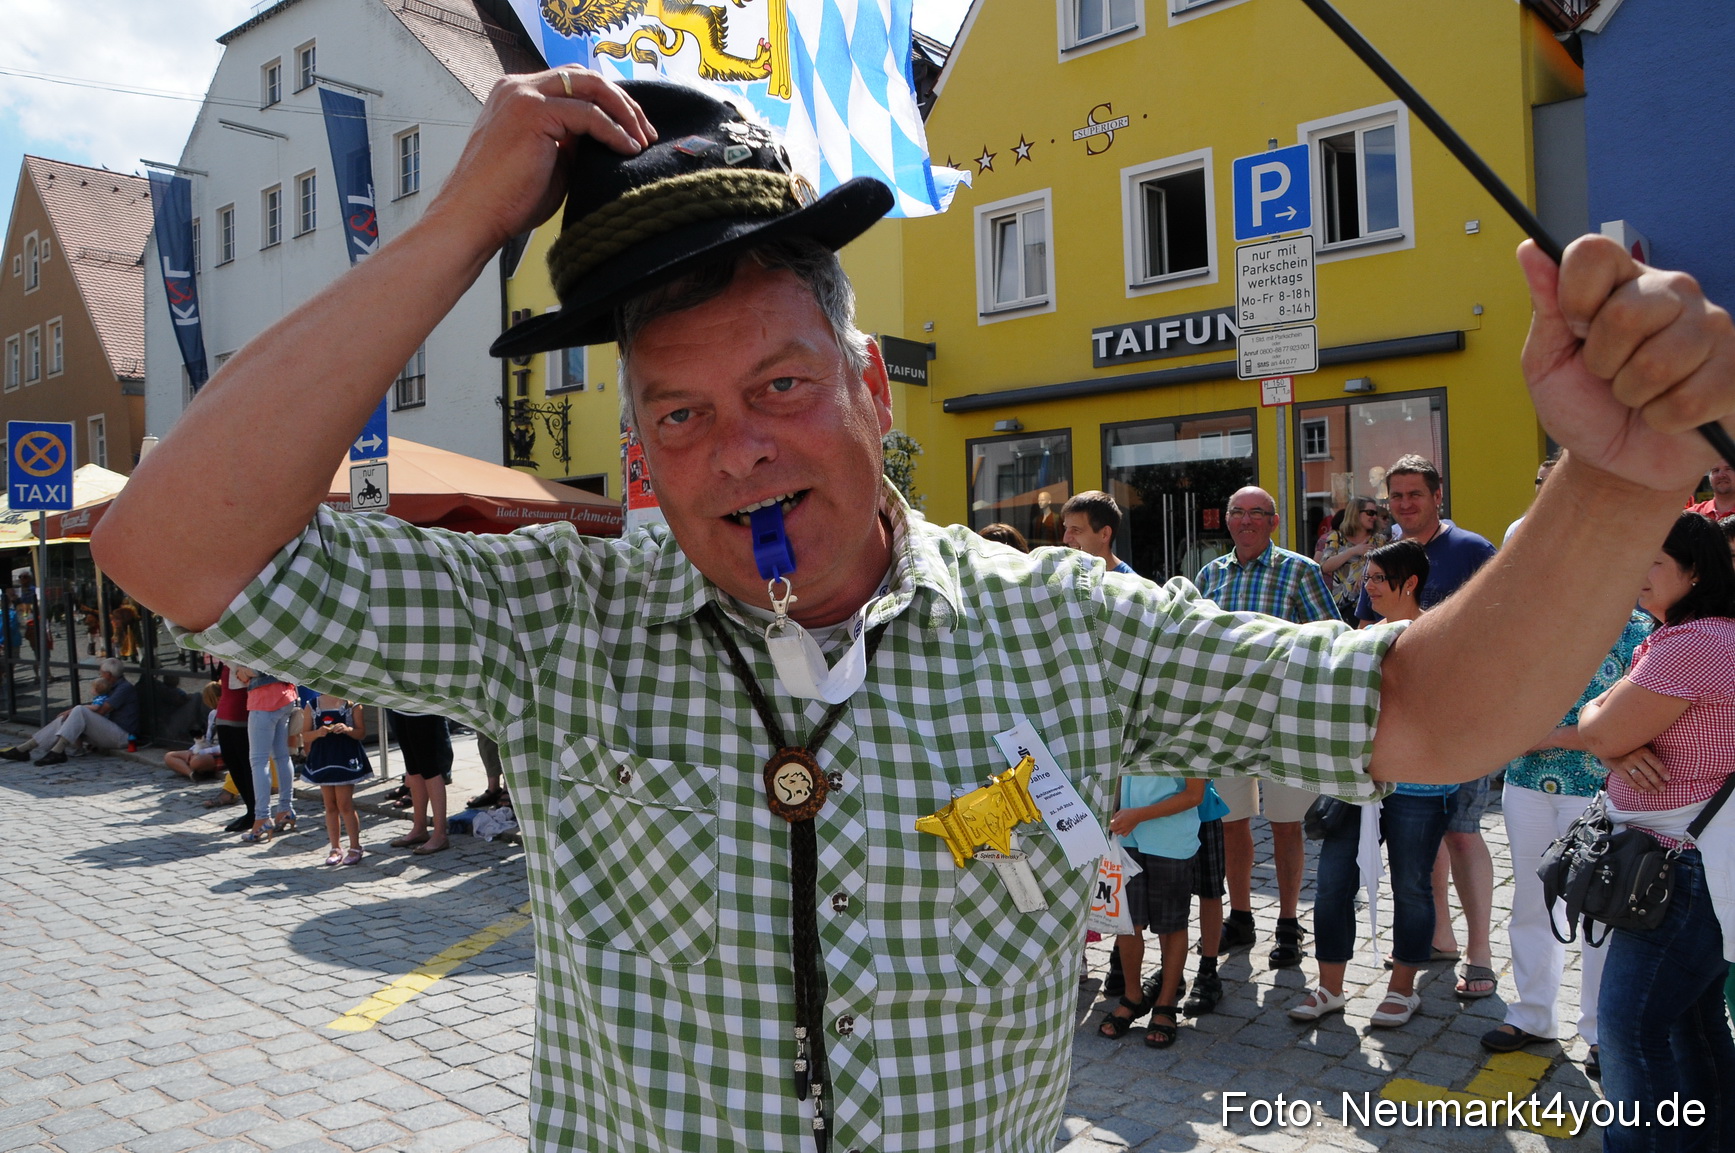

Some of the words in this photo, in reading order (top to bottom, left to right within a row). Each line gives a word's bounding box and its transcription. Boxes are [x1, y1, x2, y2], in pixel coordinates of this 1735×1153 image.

[1077, 119, 1124, 138] SUPERIOR
[1251, 161, 1291, 228] P
[1252, 250, 1271, 261] nur
[1277, 244, 1297, 258] mit
[1242, 257, 1308, 276] Parkschein
[1247, 273, 1303, 289] werktags
[163, 256, 199, 326] K&L
[1242, 310, 1255, 321] Sa
[1091, 313, 1237, 358] TAIFUN
[1275, 332, 1302, 340] Parkschein
[887, 364, 926, 379] TAIFUN
[1273, 379, 1284, 387] 150
[363, 468, 375, 477] nur
[14, 484, 66, 503] TAXI
[496, 507, 519, 518] Hotel
[521, 507, 568, 520] Restaurant
[570, 507, 622, 525] Lehmeier
[1030, 771, 1051, 784] Jahre
